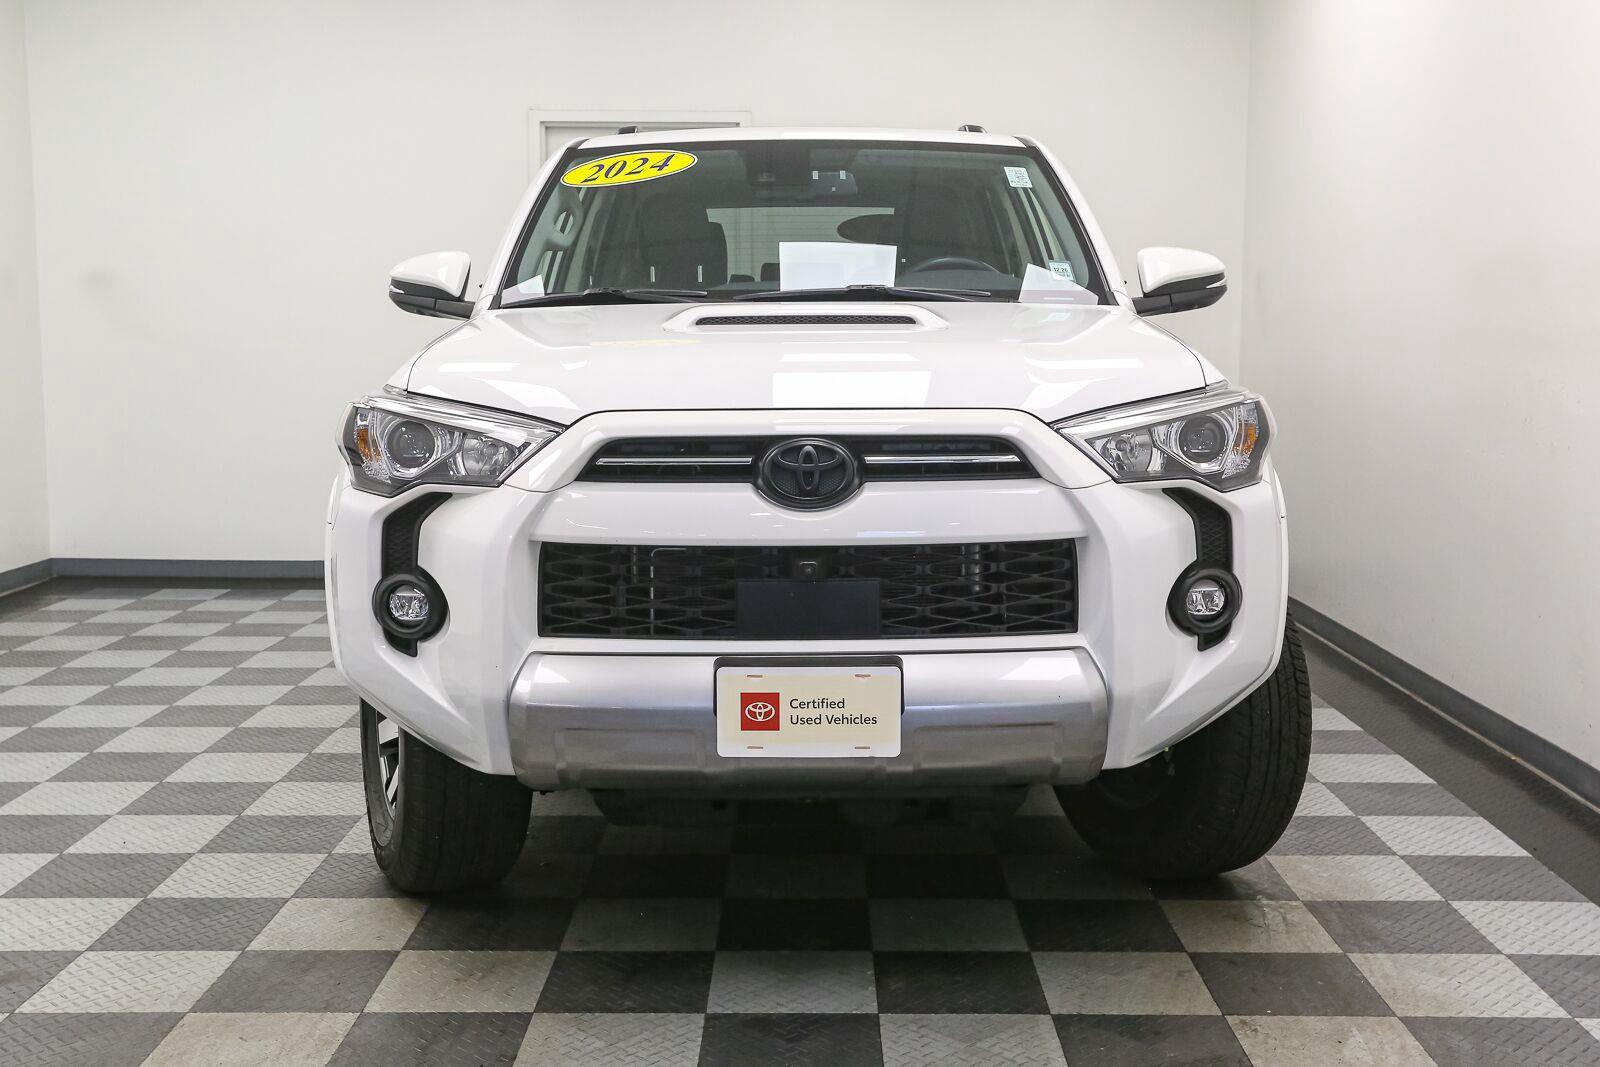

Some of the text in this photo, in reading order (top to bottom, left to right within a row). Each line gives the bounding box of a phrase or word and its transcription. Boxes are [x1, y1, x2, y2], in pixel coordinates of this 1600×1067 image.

[580, 153, 676, 183] 2024
[789, 698, 845, 709] Certified
[790, 714, 878, 725] Used Vehicles
